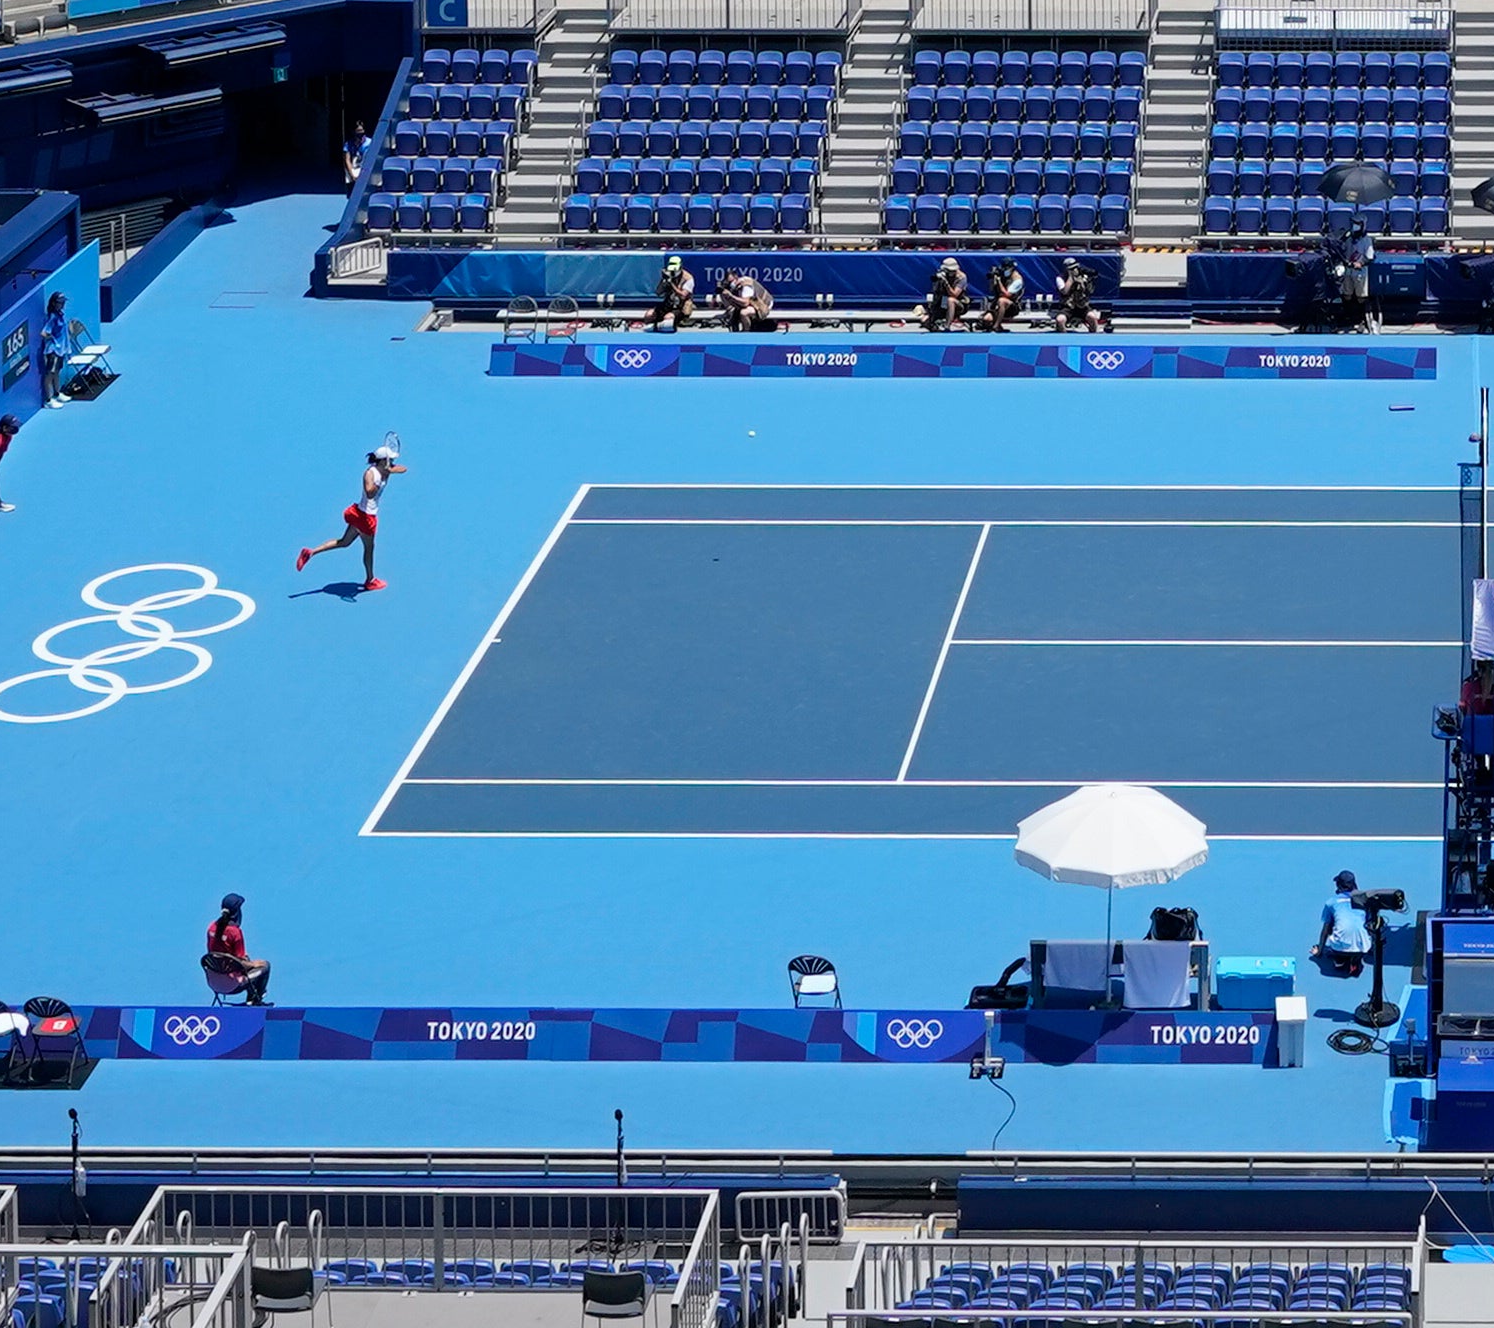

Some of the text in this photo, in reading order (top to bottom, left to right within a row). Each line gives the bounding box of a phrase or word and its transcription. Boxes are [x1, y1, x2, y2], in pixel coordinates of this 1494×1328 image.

[439, 0, 456, 22] C
[763, 267, 802, 282] 2020
[8, 328, 23, 358] 165
[786, 353, 857, 365] TOKYO 2020
[1259, 354, 1331, 369] TOKYO 2020
[427, 1020, 536, 1042] TOKYO 2020
[1150, 1024, 1260, 1046] TOKYO 2020
[1459, 1047, 1488, 1055] TOKYO
